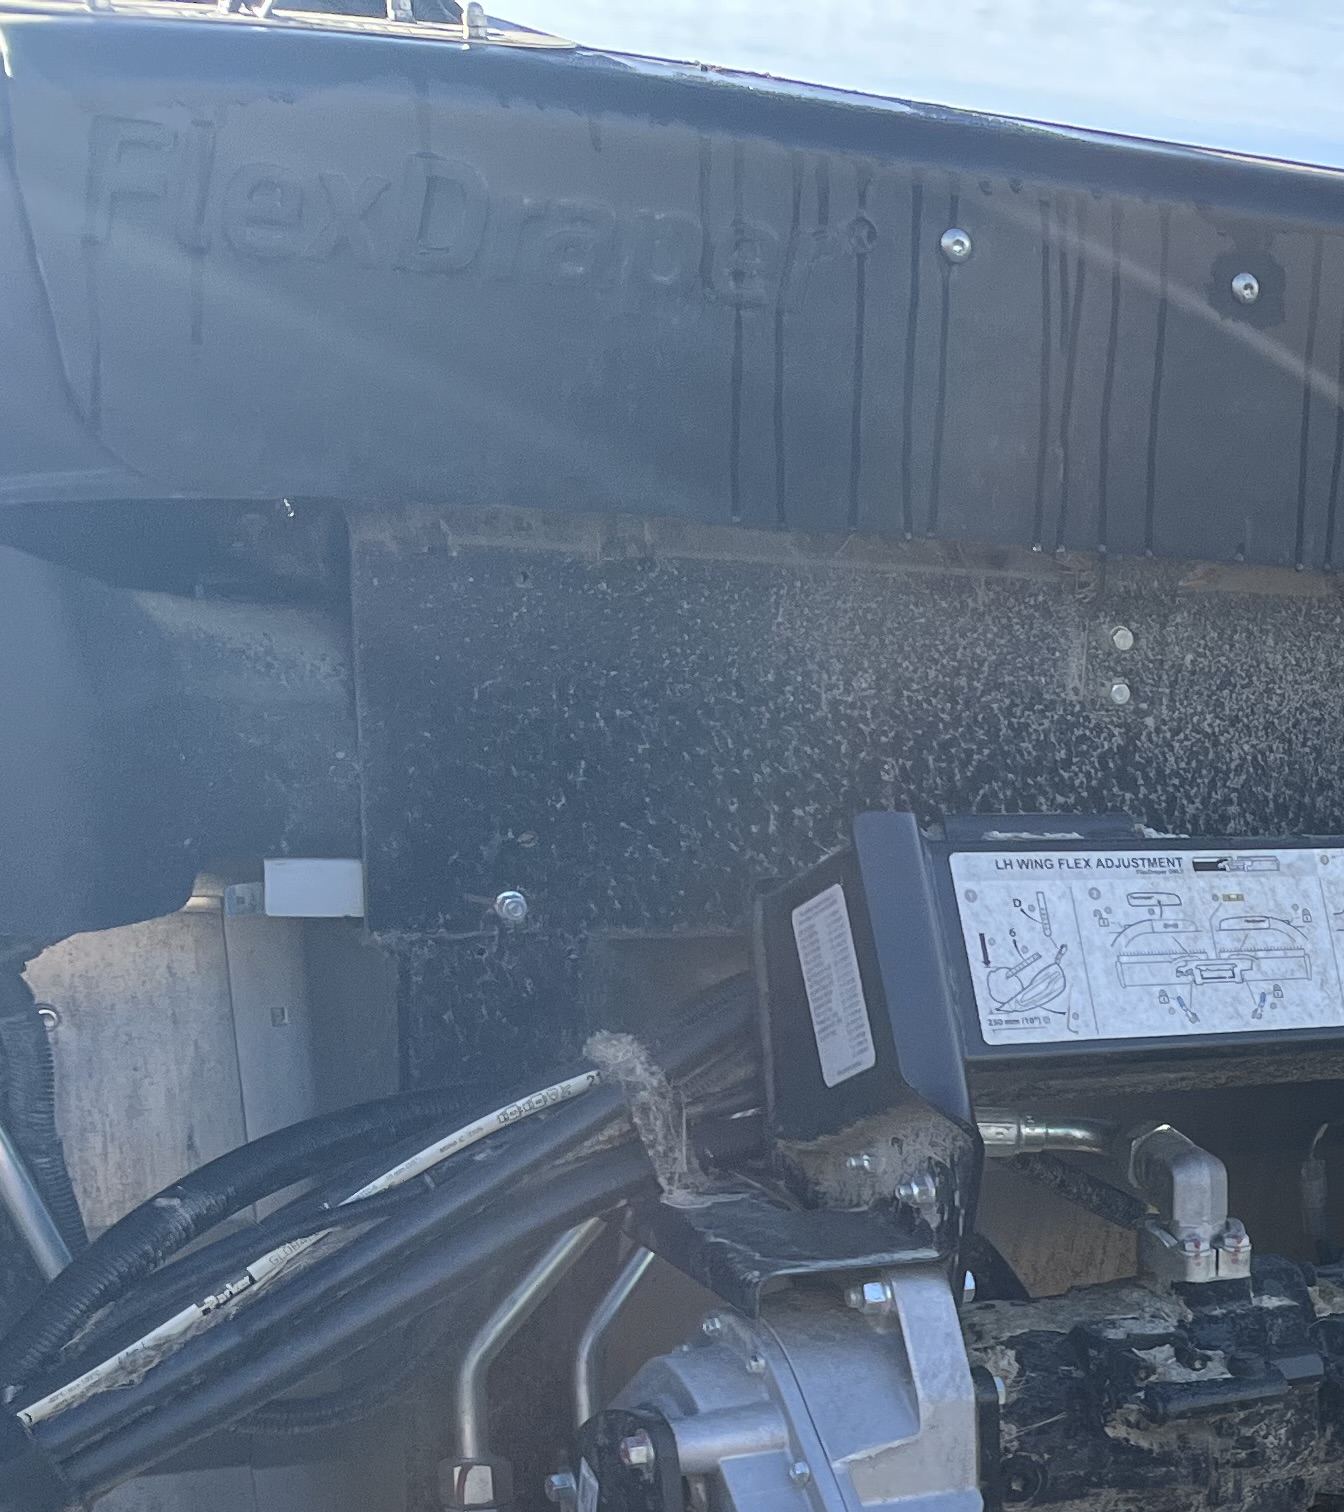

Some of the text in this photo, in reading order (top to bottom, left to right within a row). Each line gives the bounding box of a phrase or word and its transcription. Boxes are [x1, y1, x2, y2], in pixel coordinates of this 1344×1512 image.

[994, 857, 1183, 871] LH WING FLEX ADJUSTMENT
